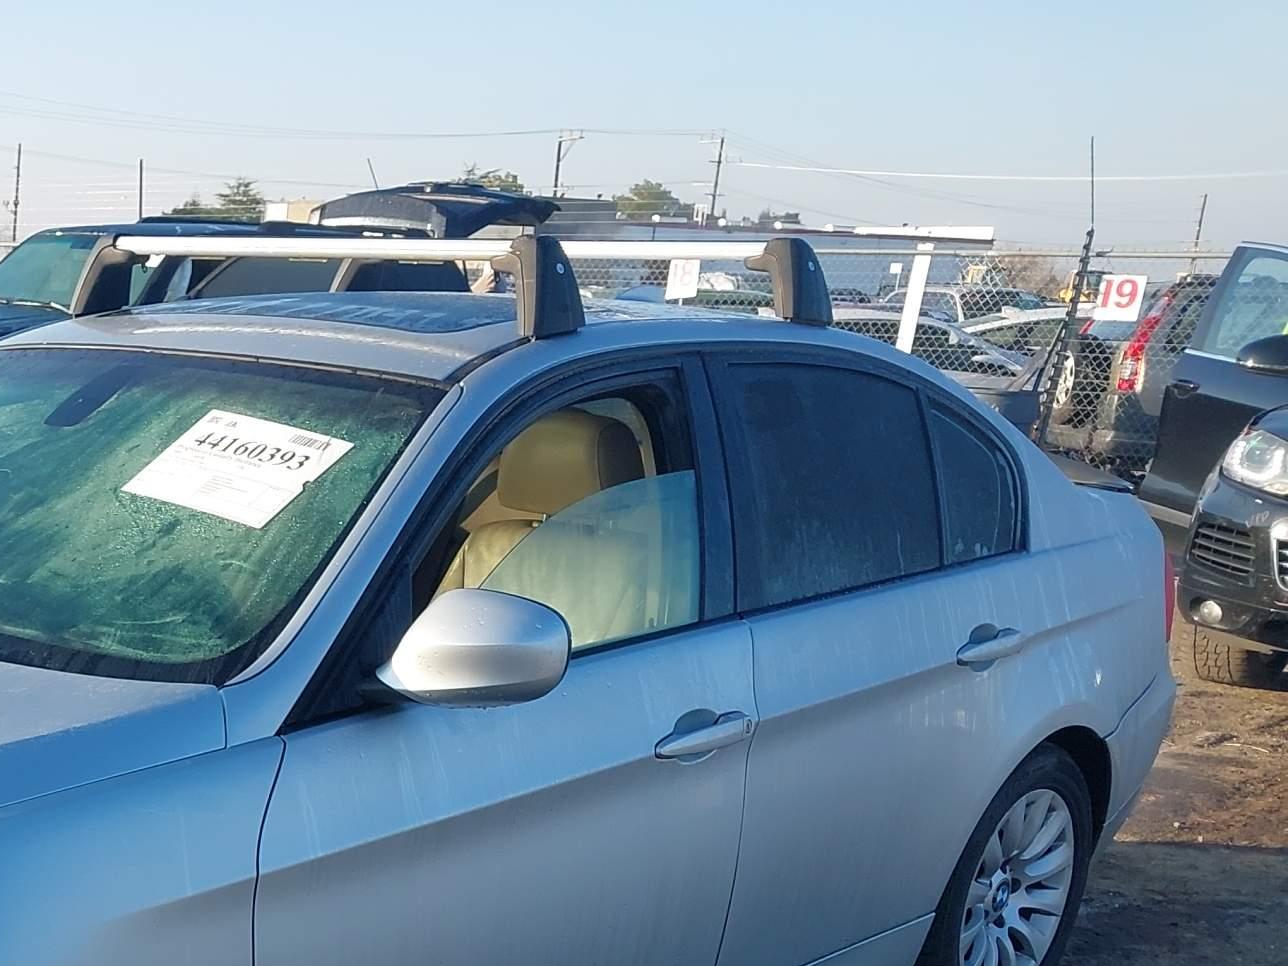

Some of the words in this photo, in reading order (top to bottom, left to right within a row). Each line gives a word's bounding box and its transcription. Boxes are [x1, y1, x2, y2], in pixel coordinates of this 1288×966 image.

[672, 261, 695, 288] 18
[1100, 279, 1139, 308] 19
[194, 432, 311, 471] 44160393
